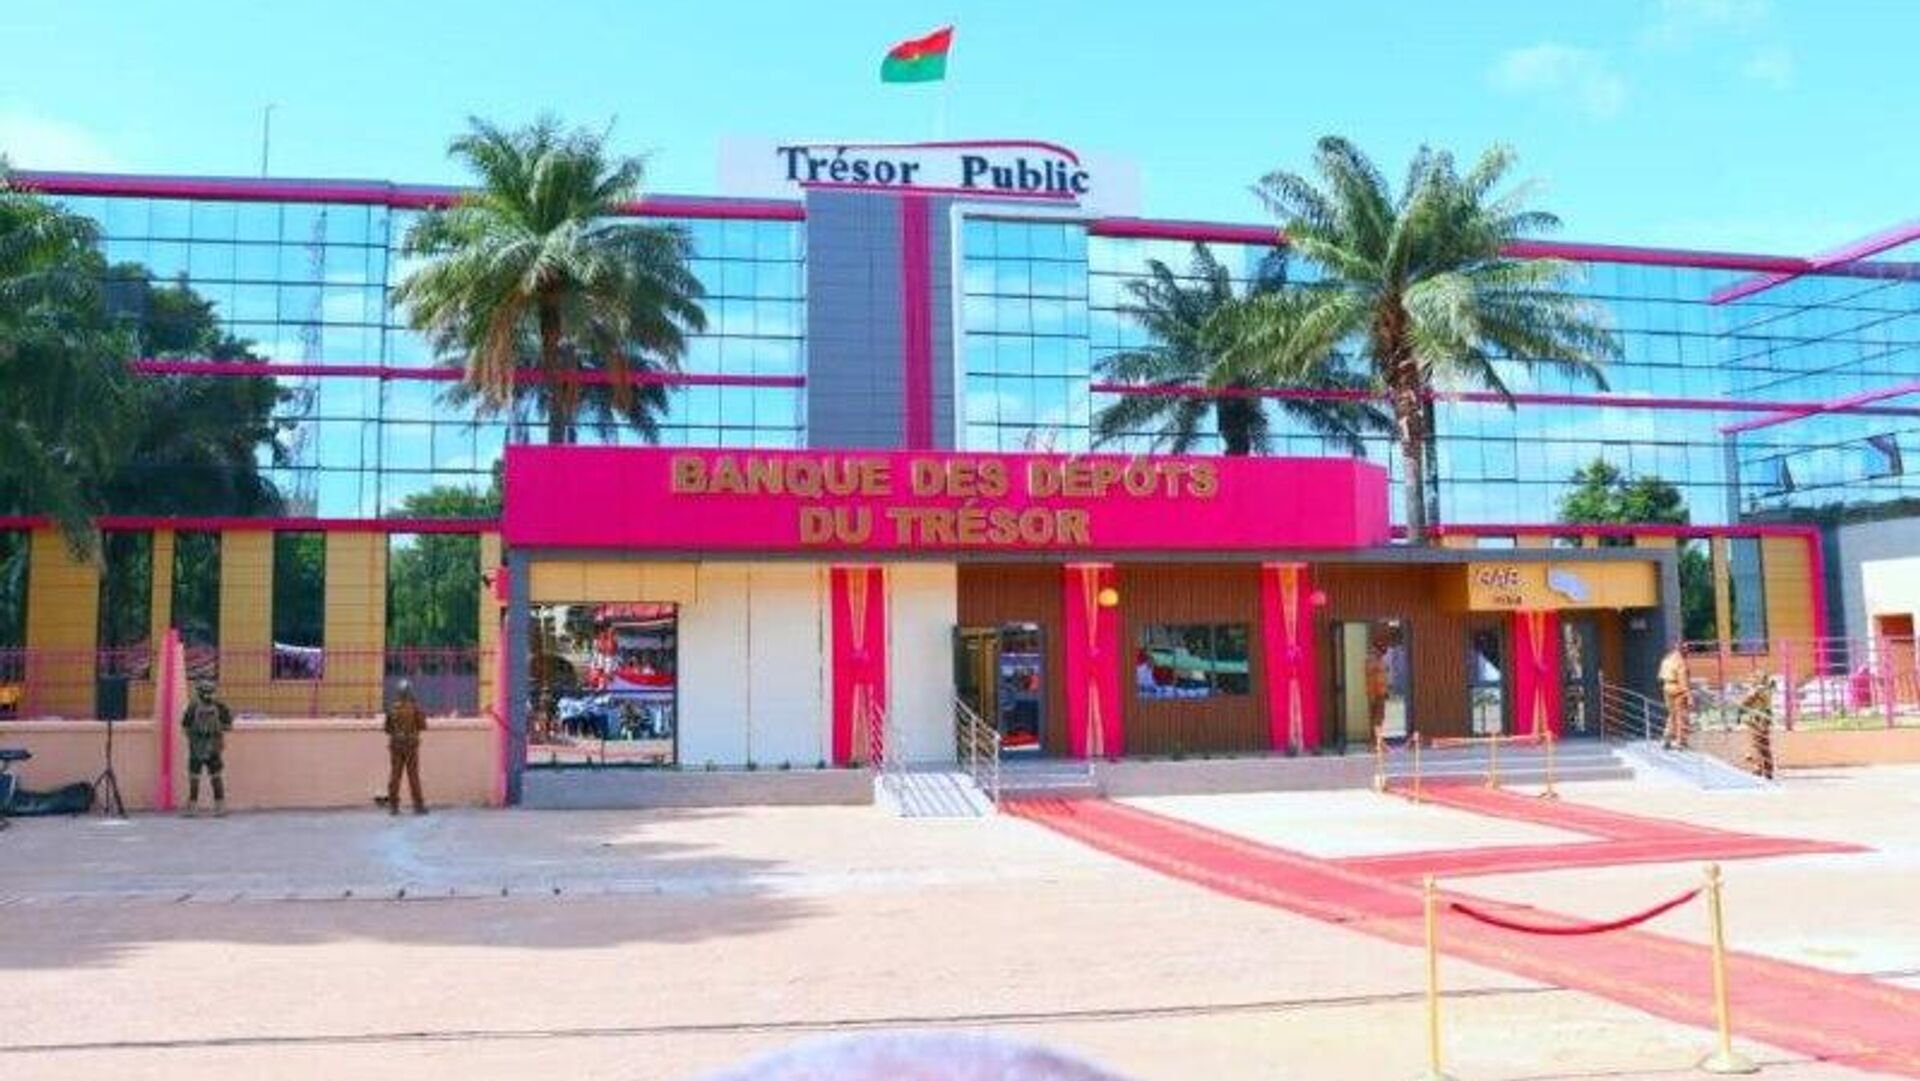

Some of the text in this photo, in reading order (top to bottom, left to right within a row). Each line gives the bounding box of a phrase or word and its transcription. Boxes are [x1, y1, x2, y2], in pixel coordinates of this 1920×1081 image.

[777, 147, 1090, 194] Trésor Public
[671, 453, 1218, 499] BANQUE DES DÉPÔTS
[799, 502, 1091, 545] DU TRÉSOR
